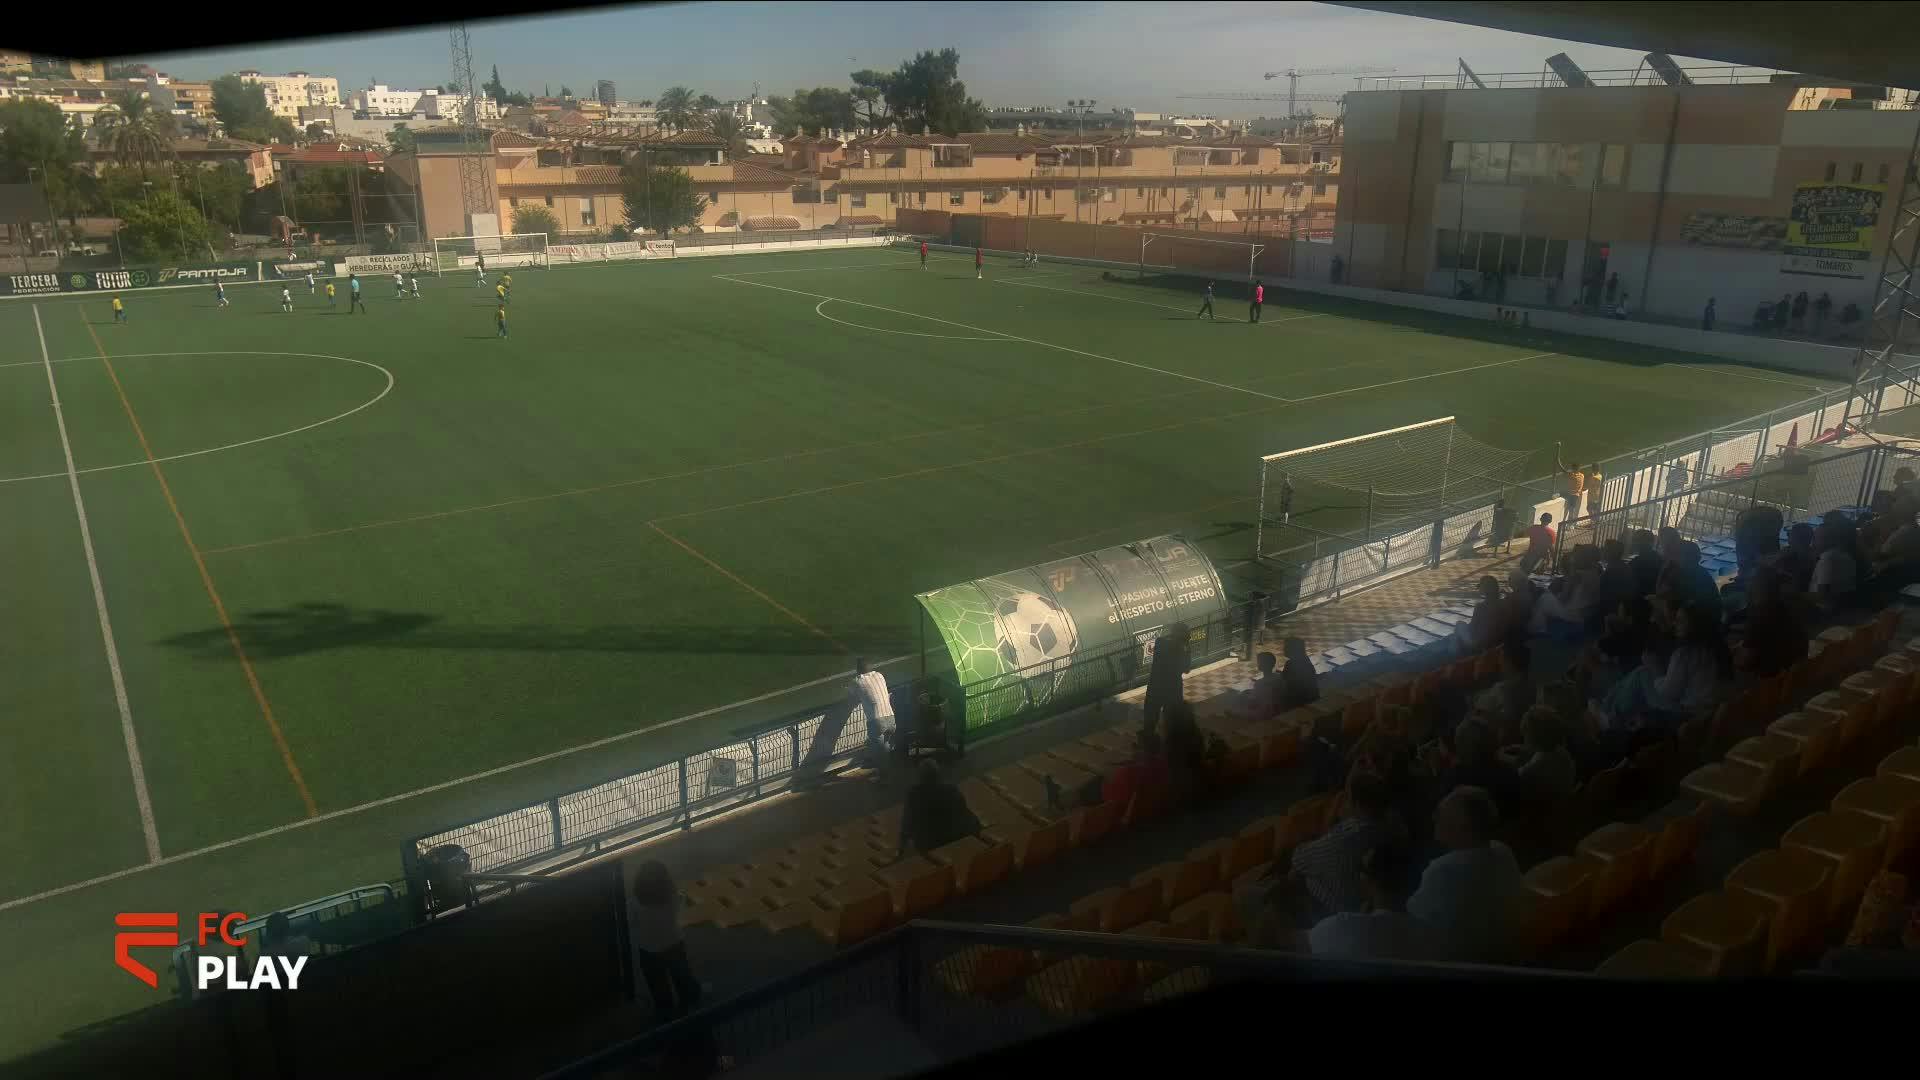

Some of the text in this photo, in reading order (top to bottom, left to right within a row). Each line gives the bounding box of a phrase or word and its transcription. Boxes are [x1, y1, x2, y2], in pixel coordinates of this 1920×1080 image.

[369, 254, 410, 263] RECICLADOS
[348, 263, 393, 272] HEREDERAS
[178, 268, 246, 280] PANTOJA
[10, 274, 59, 289] TERCERA
[1108, 611, 1119, 624] el
[1120, 600, 1164, 621] RESPETO
[1177, 587, 1215, 605] ETERNO
